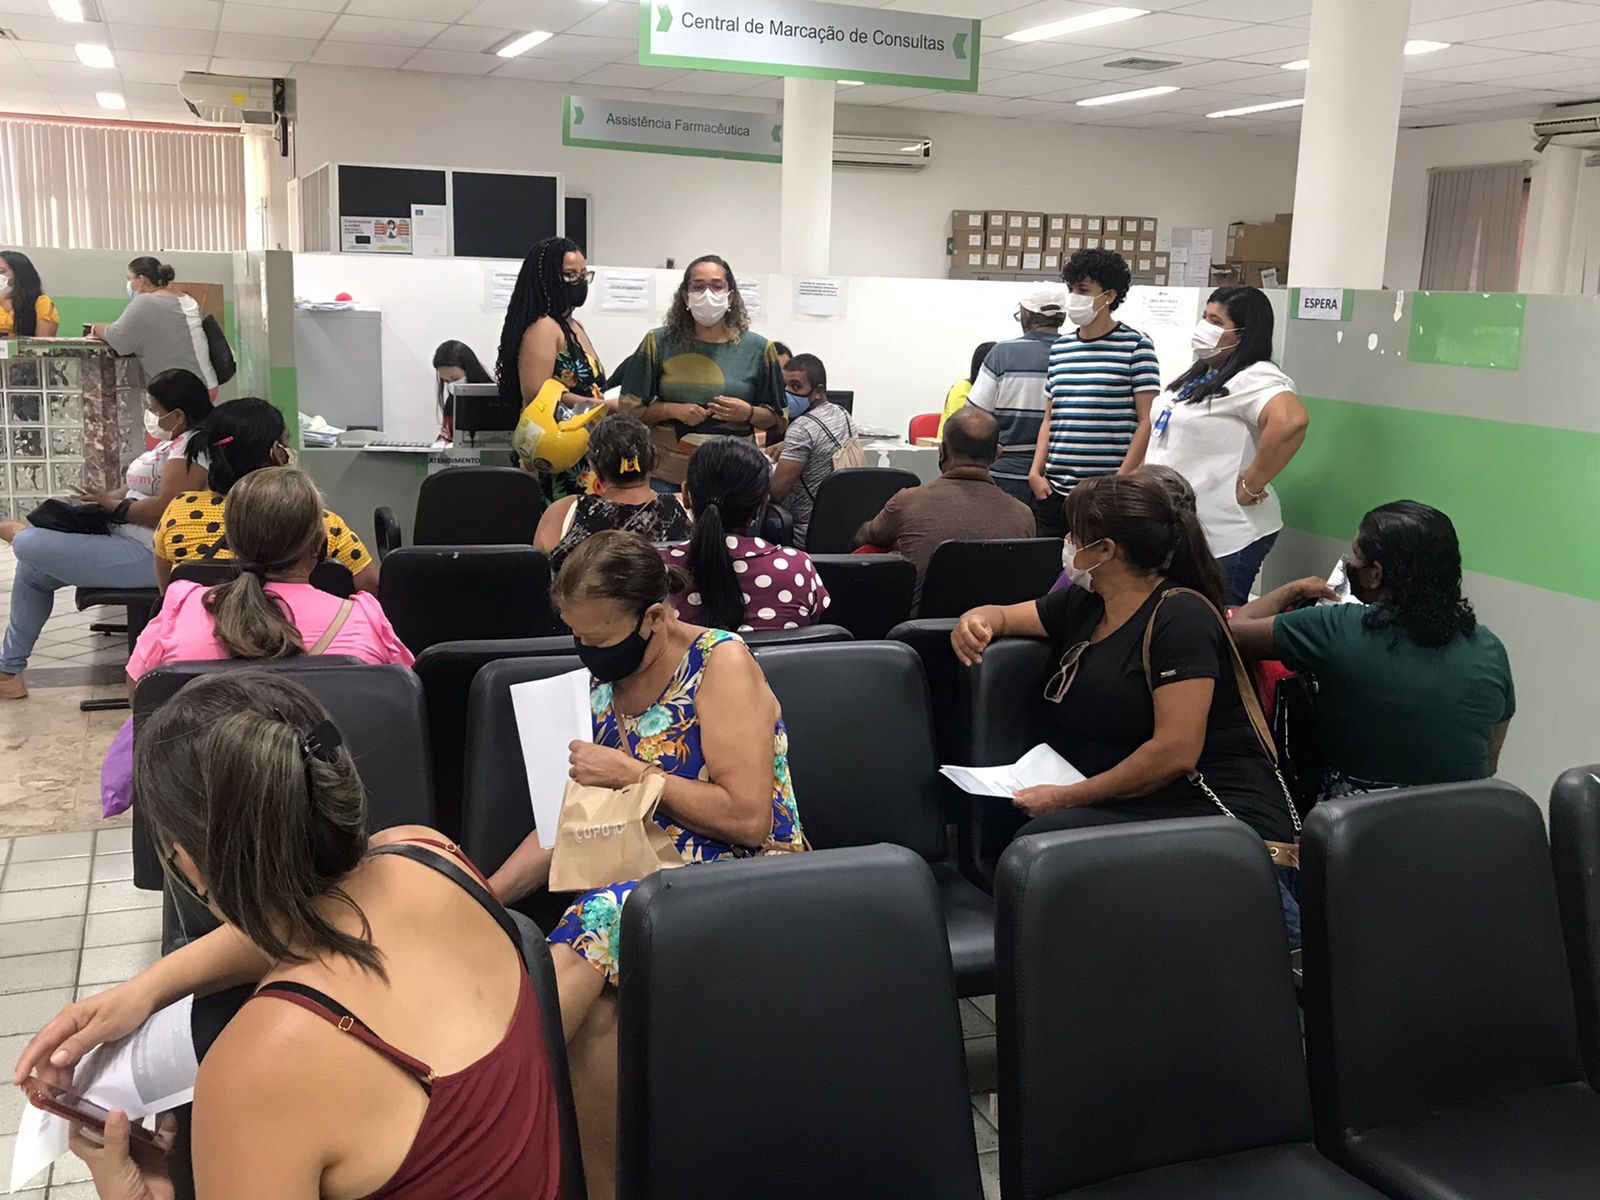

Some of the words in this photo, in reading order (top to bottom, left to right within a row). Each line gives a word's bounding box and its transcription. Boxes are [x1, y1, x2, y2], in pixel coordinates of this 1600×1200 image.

[682, 12, 739, 32] Central
[745, 18, 764, 34] de
[769, 20, 845, 43] Marcação
[849, 28, 868, 43] de
[873, 30, 945, 51] Consultas
[606, 113, 671, 130] Assistência
[675, 119, 750, 136] Farmacêutica
[1304, 298, 1338, 309] ESPERA
